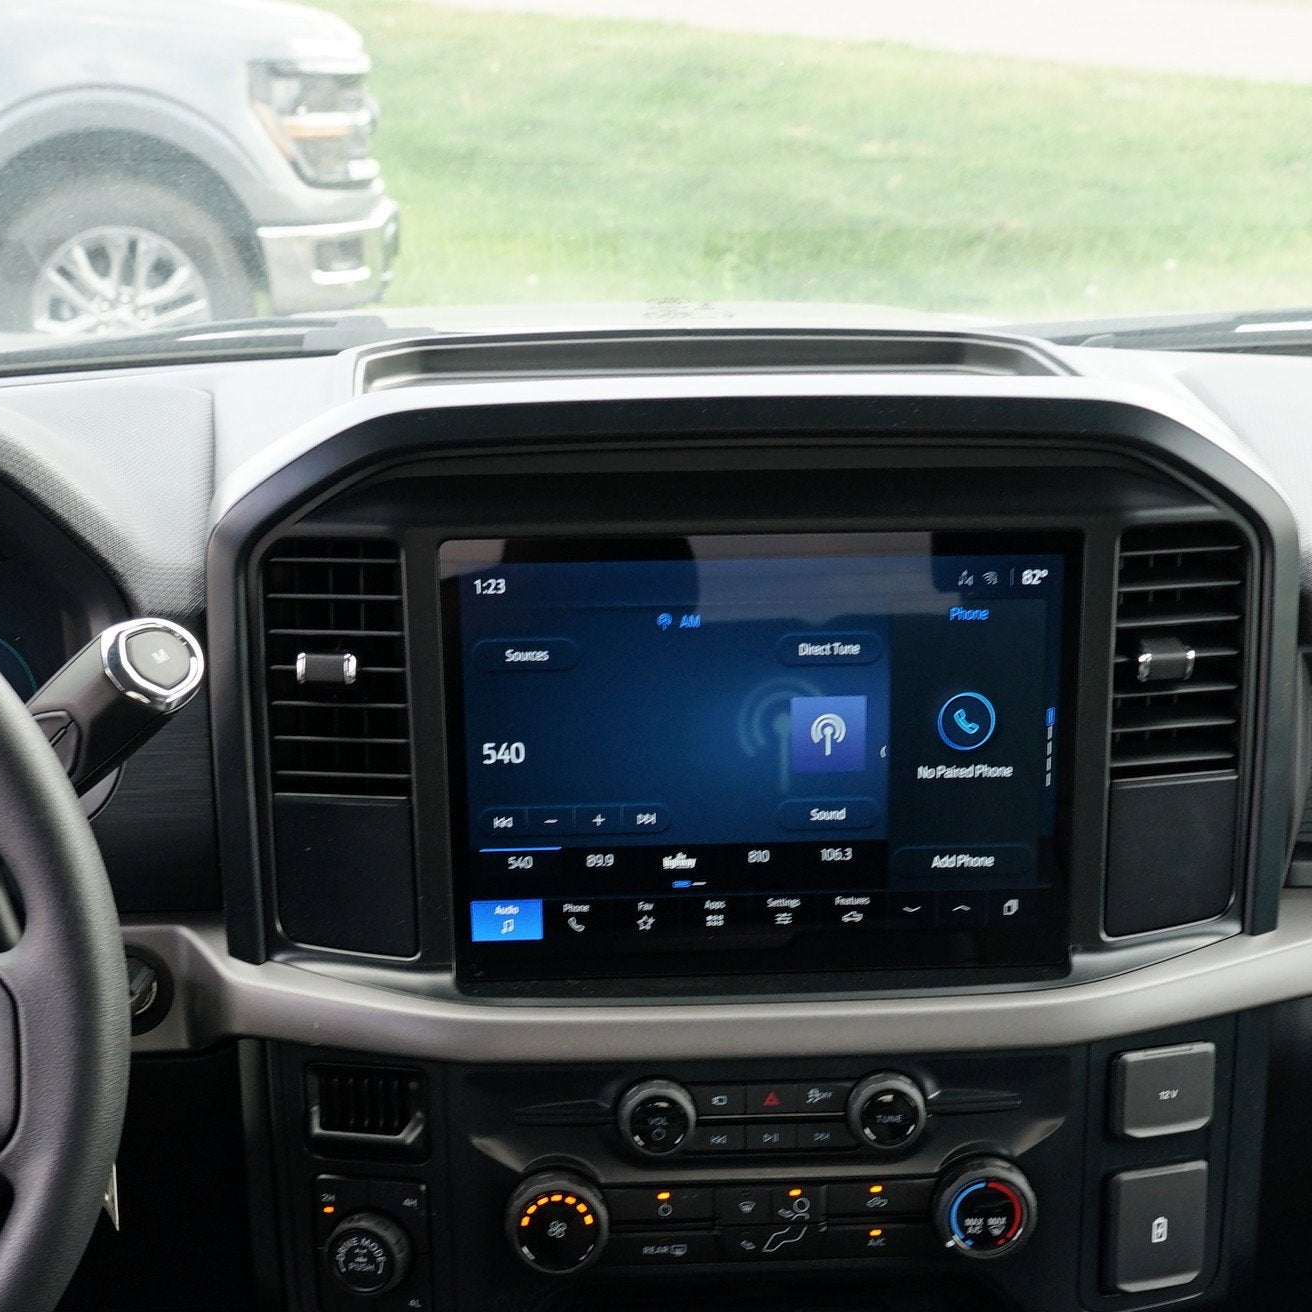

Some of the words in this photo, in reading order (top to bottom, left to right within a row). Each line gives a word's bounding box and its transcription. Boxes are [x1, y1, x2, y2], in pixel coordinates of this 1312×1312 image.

[473, 578, 506, 594] 1:23
[949, 606, 989, 621] Phone
[679, 614, 701, 629] AM
[505, 649, 549, 662] Sources
[798, 643, 832, 656] Direct
[831, 642, 861, 655] Tune
[481, 741, 527, 766] 540
[917, 765, 936, 779] No
[936, 764, 975, 778] Paired
[974, 763, 1014, 778] Phone
[810, 807, 846, 821] Sound
[585, 854, 615, 867] 89.9
[747, 850, 770, 863] 810
[820, 848, 853, 861] 106.3
[931, 854, 957, 868] Add
[956, 854, 995, 867] Phone
[508, 856, 534, 869] 540
[637, 901, 654, 912] Fav
[704, 900, 726, 910] Apps
[766, 898, 801, 908] Settings
[835, 895, 870, 906] Features
[494, 905, 519, 915] Audio
[563, 902, 590, 914] Phone
[1158, 1088, 1179, 1100] 12V
